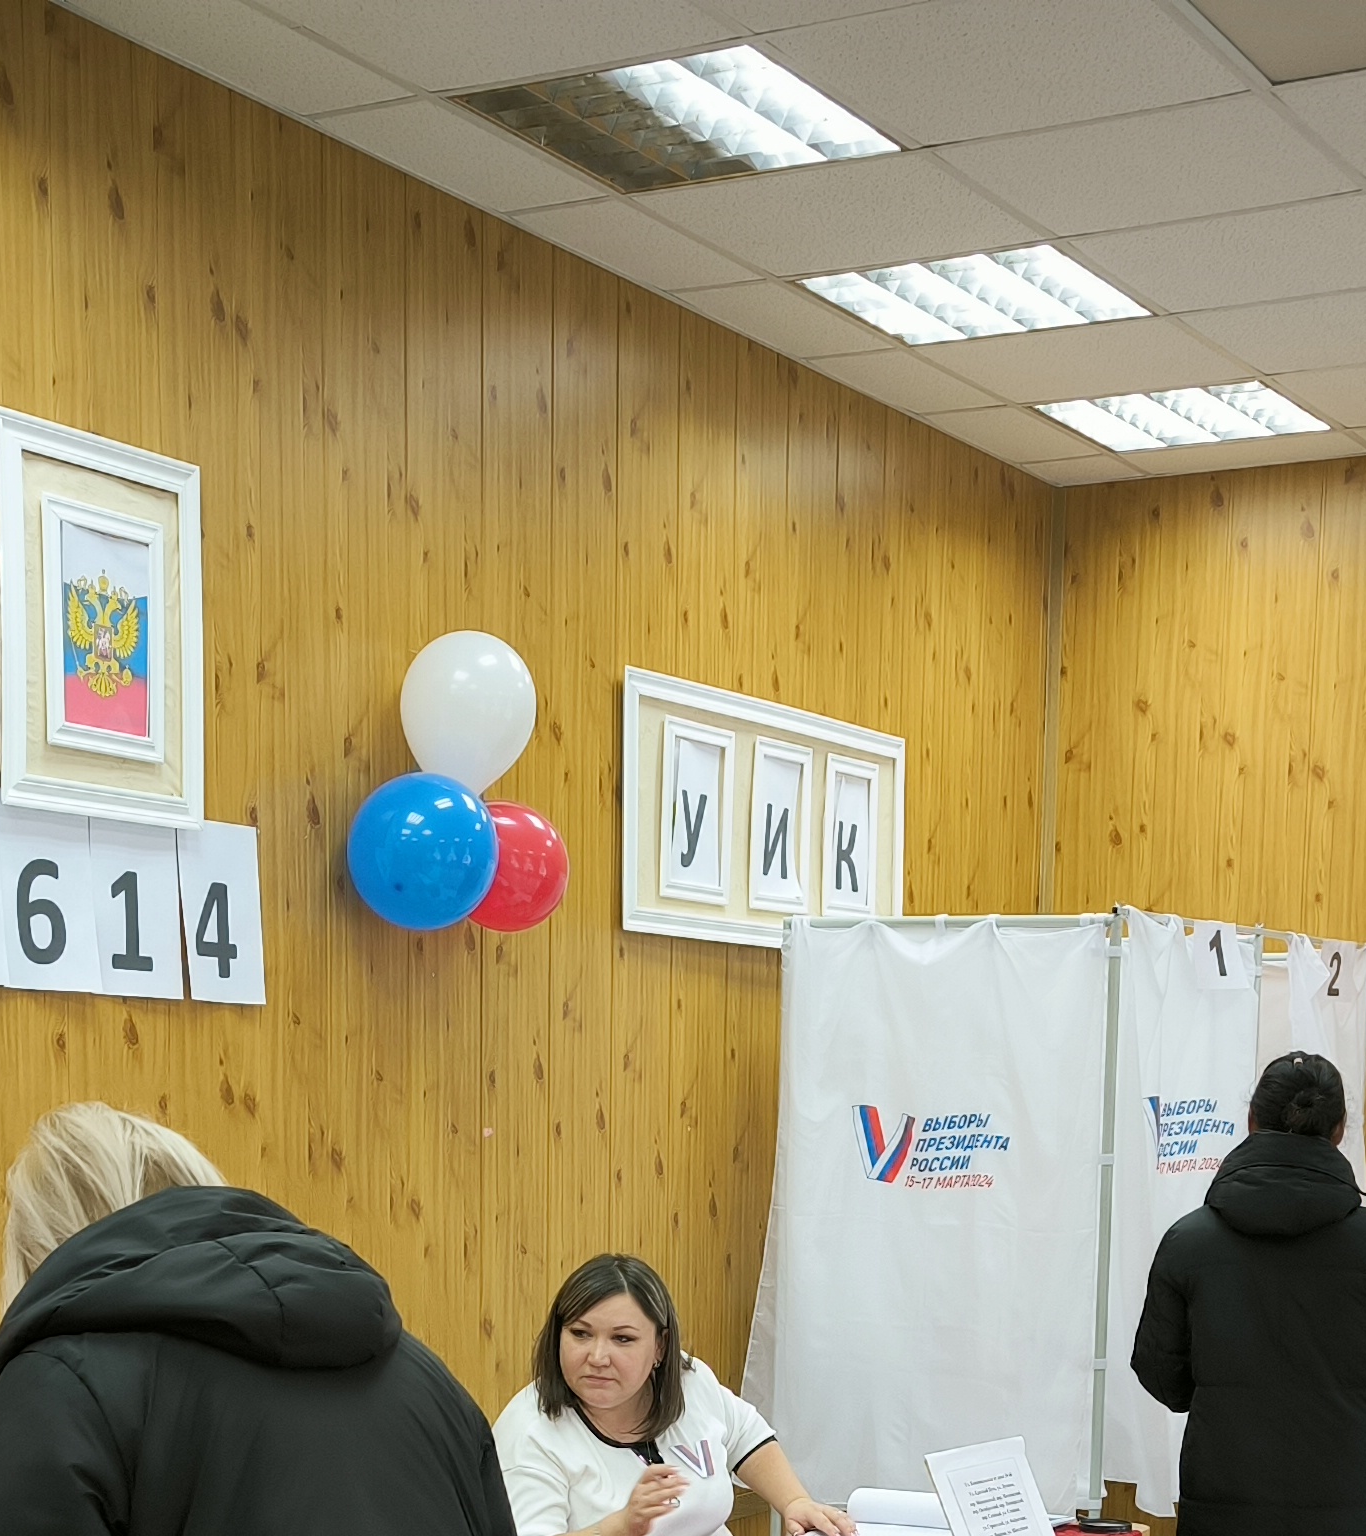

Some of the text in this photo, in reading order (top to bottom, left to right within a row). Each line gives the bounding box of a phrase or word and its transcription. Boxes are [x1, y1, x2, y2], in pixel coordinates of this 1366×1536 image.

[1209, 930, 1228, 977] 1
[1327, 951, 1342, 996] 2
[922, 1113, 991, 1133] ВЫБОРЫ
[915, 1134, 1010, 1152] ПРЕЗИДЕНТА
[910, 1155, 971, 1172] РОССИИ
[934, 1175, 971, 1189] МАРТА
